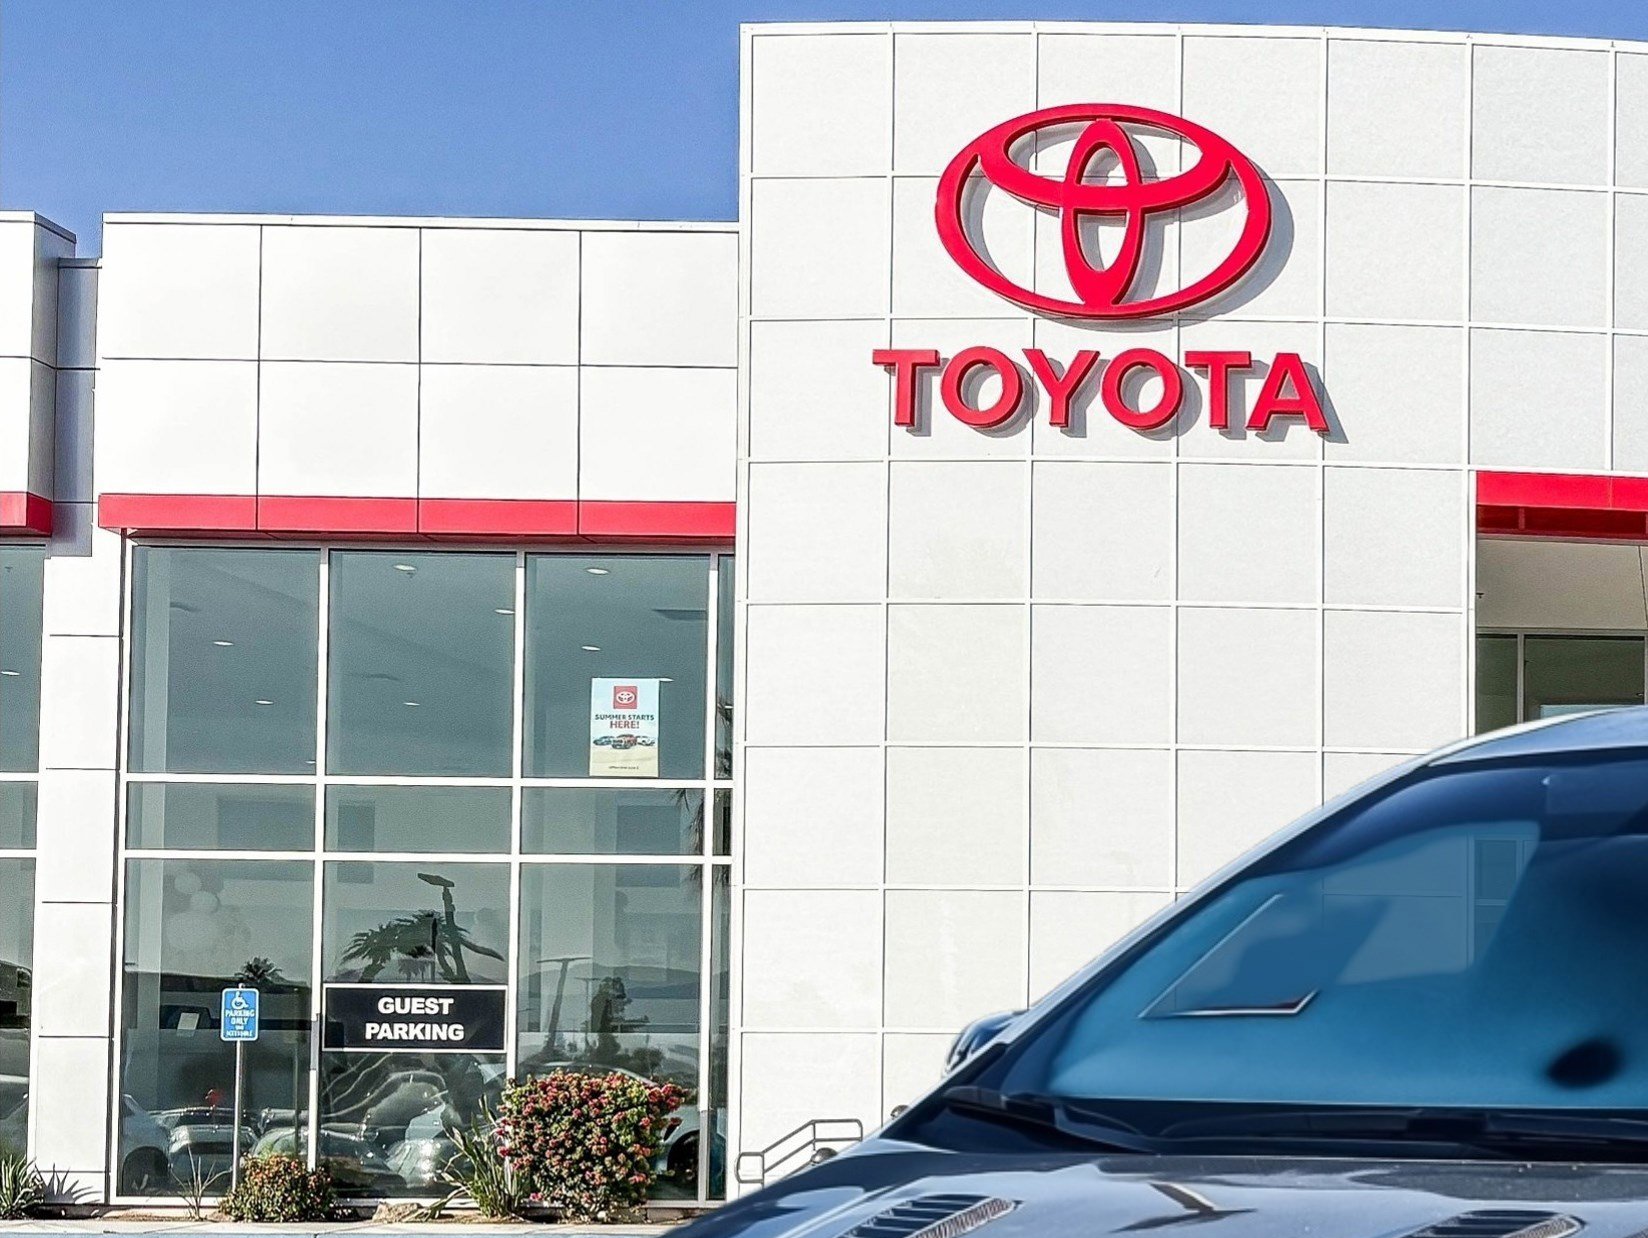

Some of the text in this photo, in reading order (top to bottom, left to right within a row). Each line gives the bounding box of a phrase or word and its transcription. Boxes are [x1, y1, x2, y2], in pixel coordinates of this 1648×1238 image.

[872, 346, 1330, 432] TOYOTA
[610, 720, 640, 729] HERE!
[377, 997, 454, 1015] GUEST
[364, 1023, 465, 1041] PARKING
